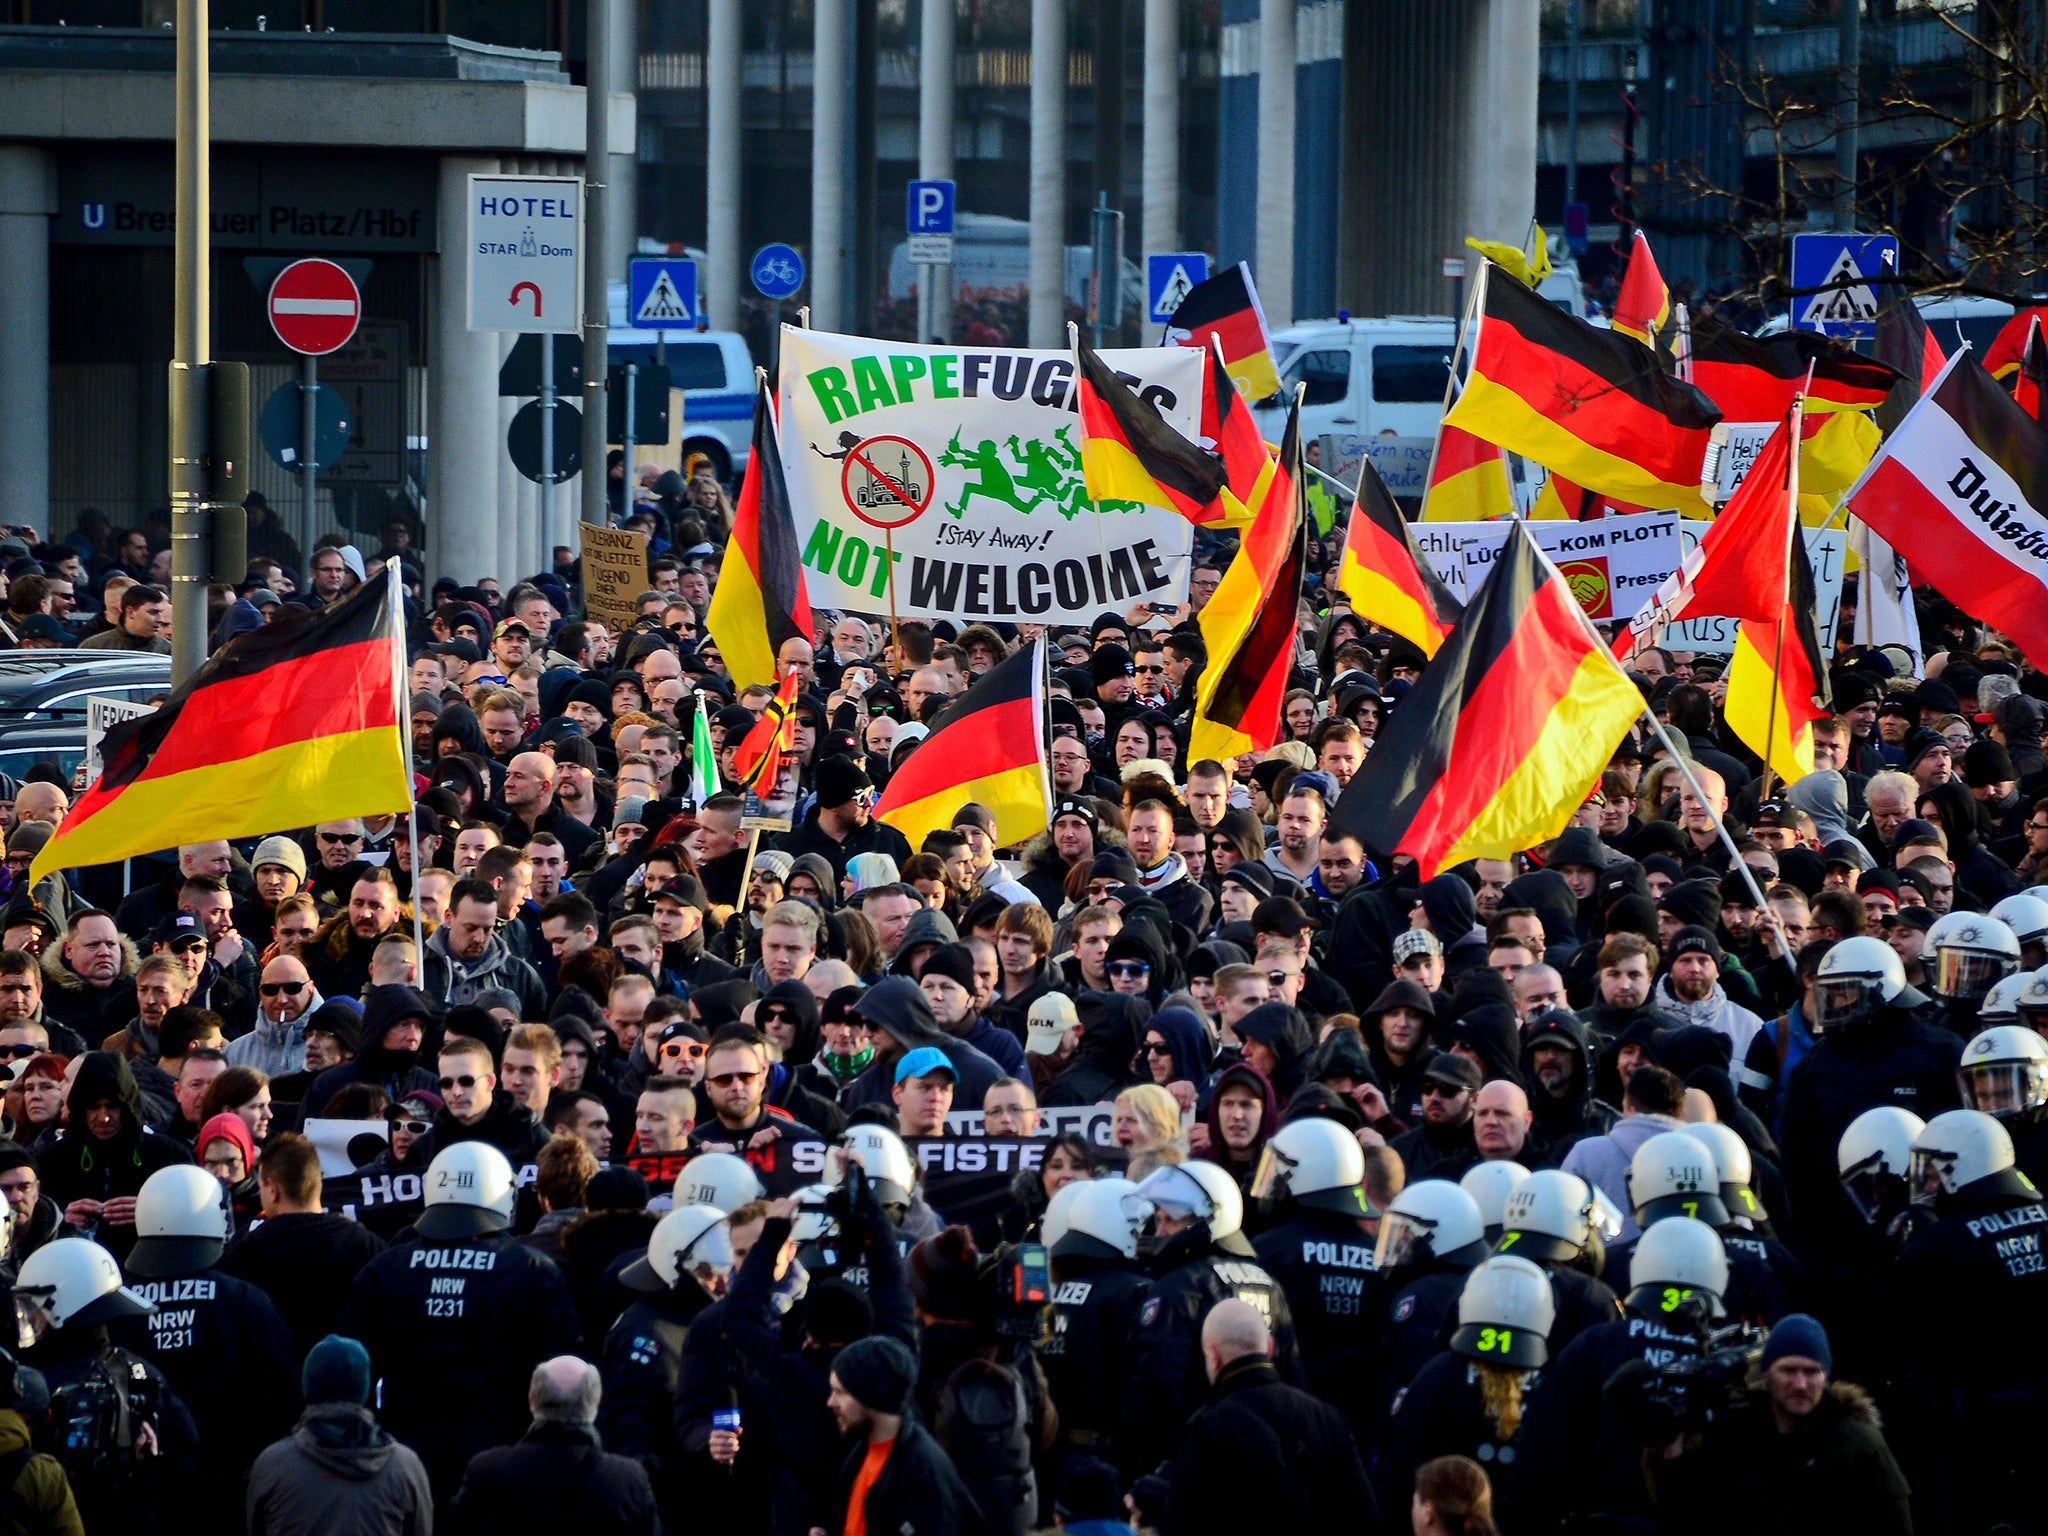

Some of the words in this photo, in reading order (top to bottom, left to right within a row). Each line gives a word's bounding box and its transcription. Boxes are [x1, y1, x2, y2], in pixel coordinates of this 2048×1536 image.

[82, 203, 105, 228] U
[115, 203, 259, 233] Bresuer
[481, 197, 573, 219] HOTEL
[918, 187, 945, 228] P
[478, 243, 517, 255] STAR
[541, 245, 573, 257] Dom
[584, 527, 635, 550] TOLERANZ
[1611, 521, 1675, 544] PLOTT
[605, 552, 642, 567] LETZTE
[802, 518, 902, 599] NOT
[910, 538, 1172, 615] WELCOME
[590, 564, 631, 585] TUGEND
[1966, 1203, 2048, 1238] POLIZEI
[1996, 1234, 2039, 1258] NRW
[409, 1248, 497, 1271] POLIZEI
[2006, 1253, 2047, 1277] 1332
[430, 1278, 466, 1296] NRW
[1320, 1274, 1364, 1296] NRW
[148, 1309, 196, 1330] NRW
[425, 1299, 464, 1318] 1231
[153, 1330, 193, 1350] 1231
[1477, 1328, 1512, 1354] 31
